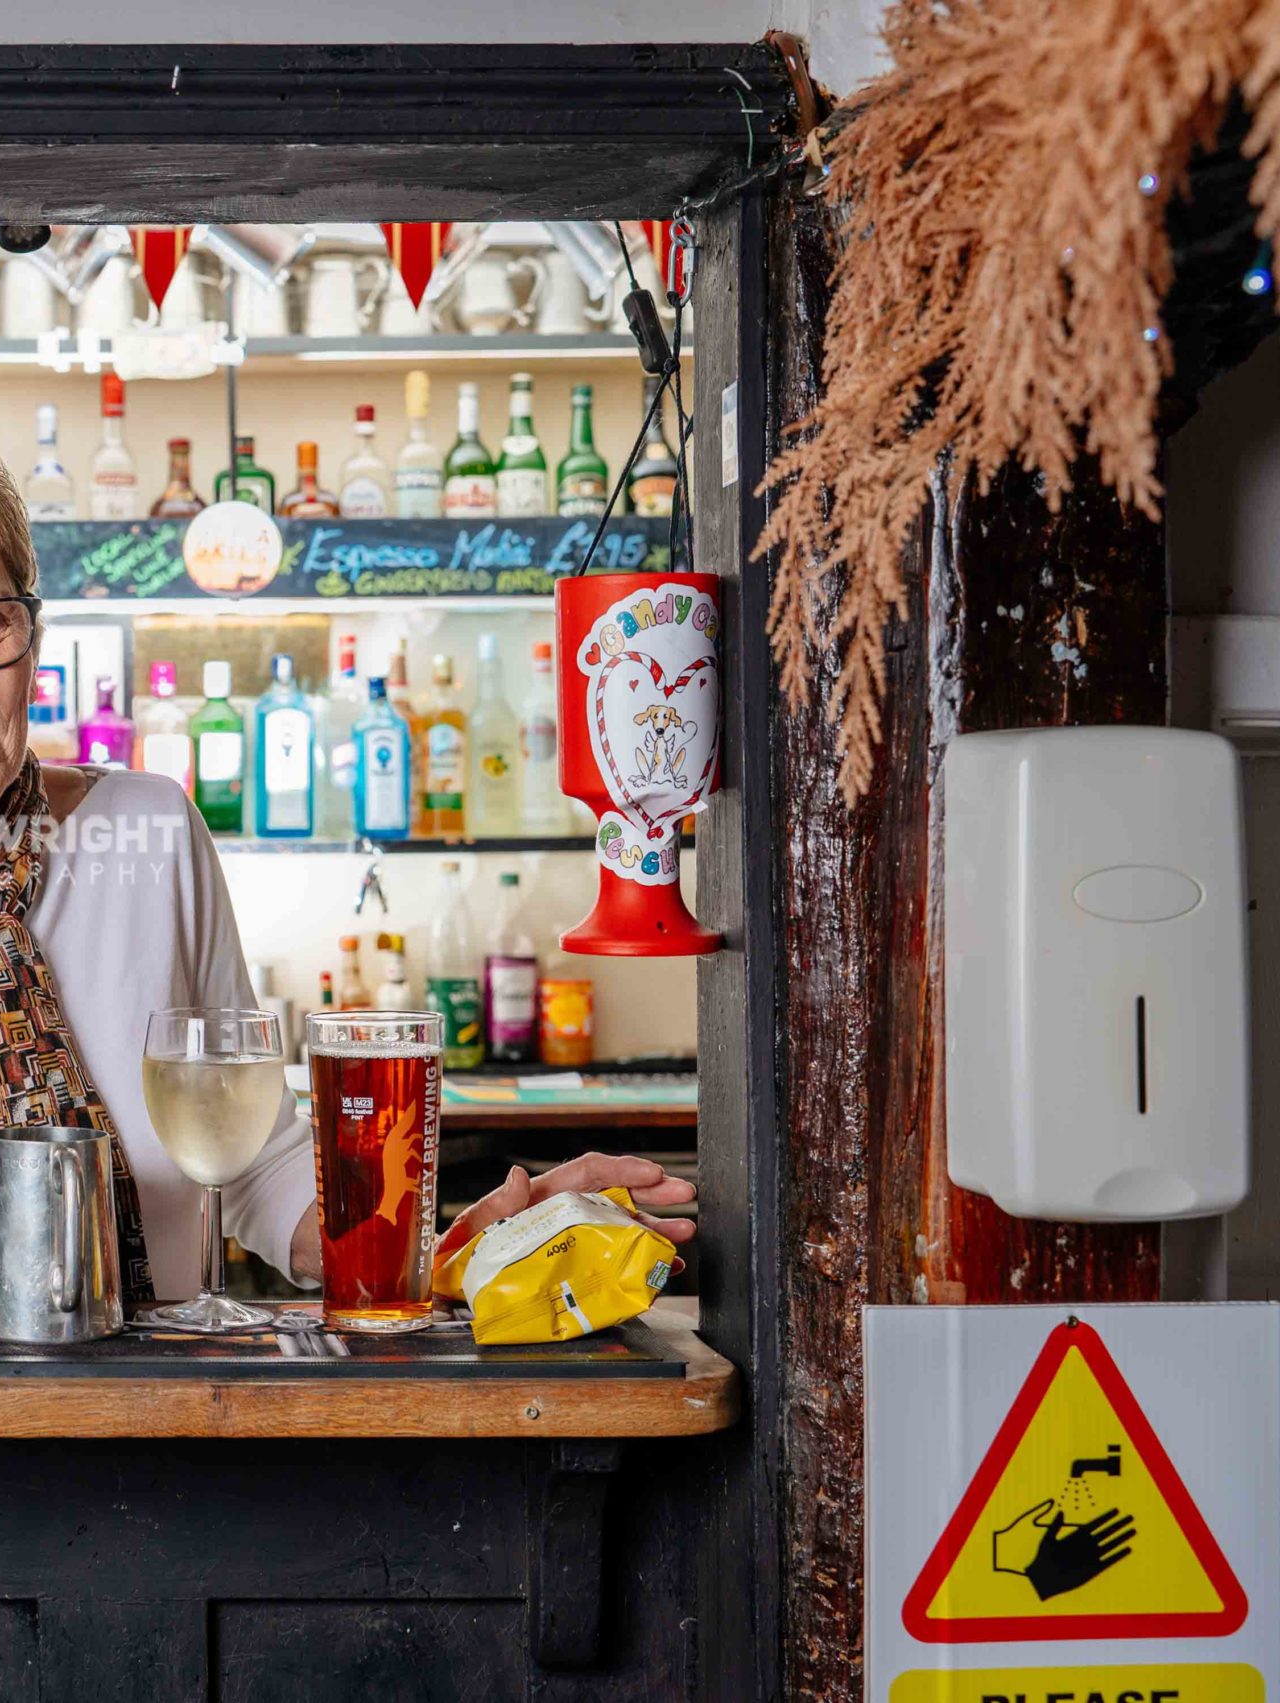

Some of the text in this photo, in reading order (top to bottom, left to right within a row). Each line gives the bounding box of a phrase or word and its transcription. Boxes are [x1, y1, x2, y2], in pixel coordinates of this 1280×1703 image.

[599, 593, 693, 657] Candy
[423, 1066, 437, 1164] BREWING
[421, 1169, 434, 1251] CRAFTY
